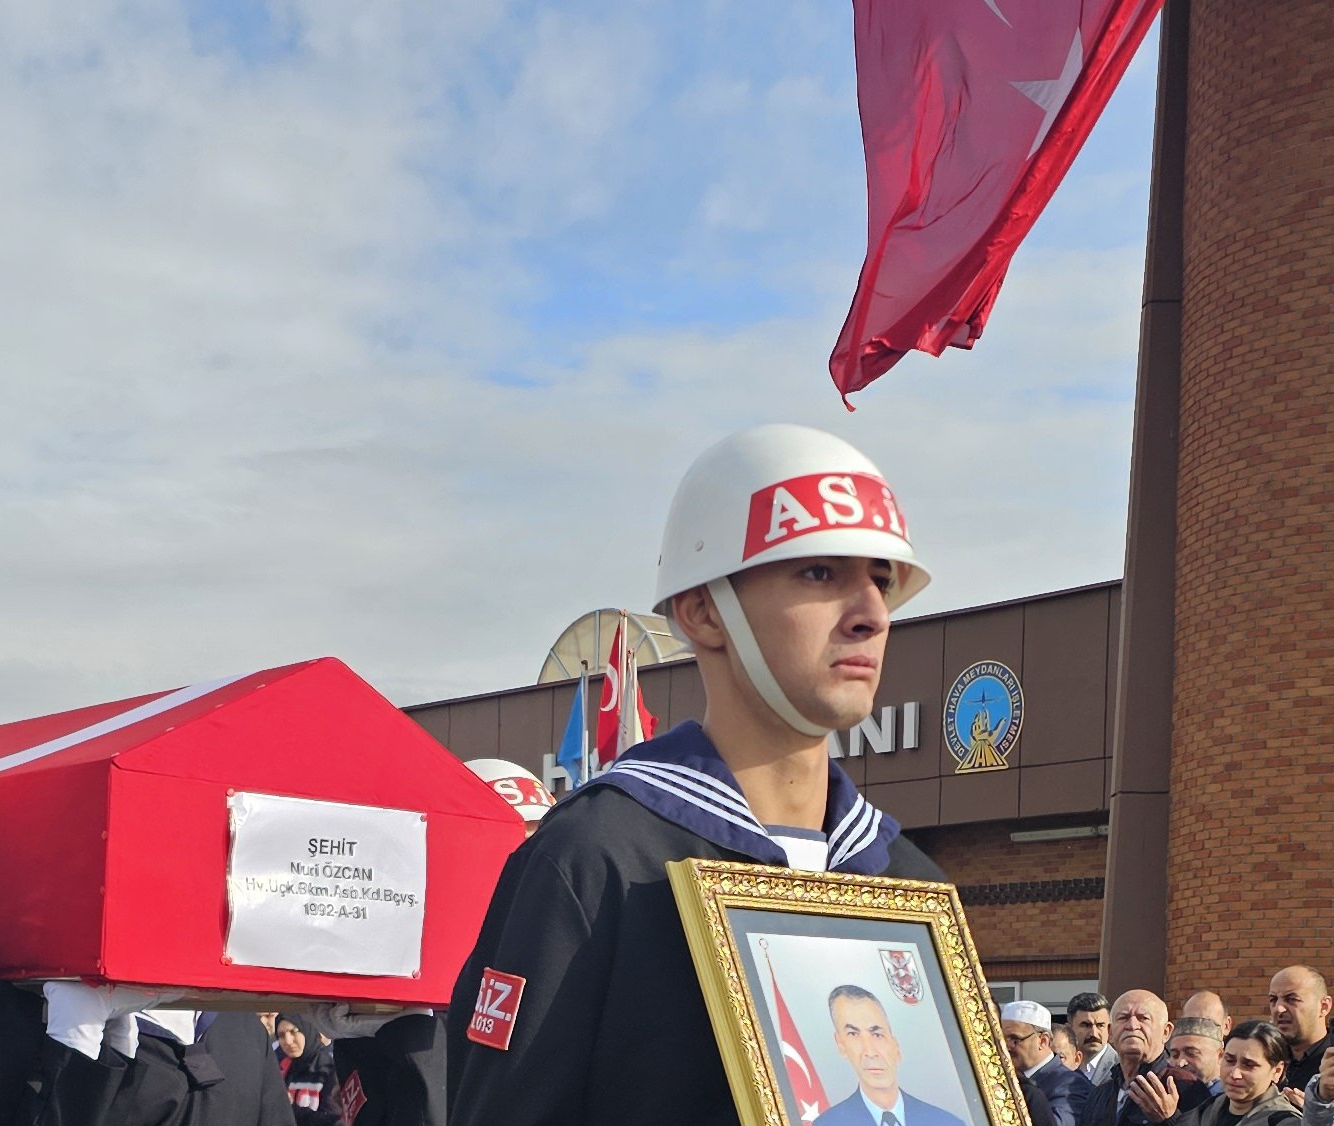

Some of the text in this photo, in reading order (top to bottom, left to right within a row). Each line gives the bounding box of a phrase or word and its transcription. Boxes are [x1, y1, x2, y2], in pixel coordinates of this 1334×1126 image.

[307, 838, 358, 857] ŞEHİT
[290, 861, 373, 881] Nuri ÖZCAN
[304, 903, 368, 919] 1992-A-31
